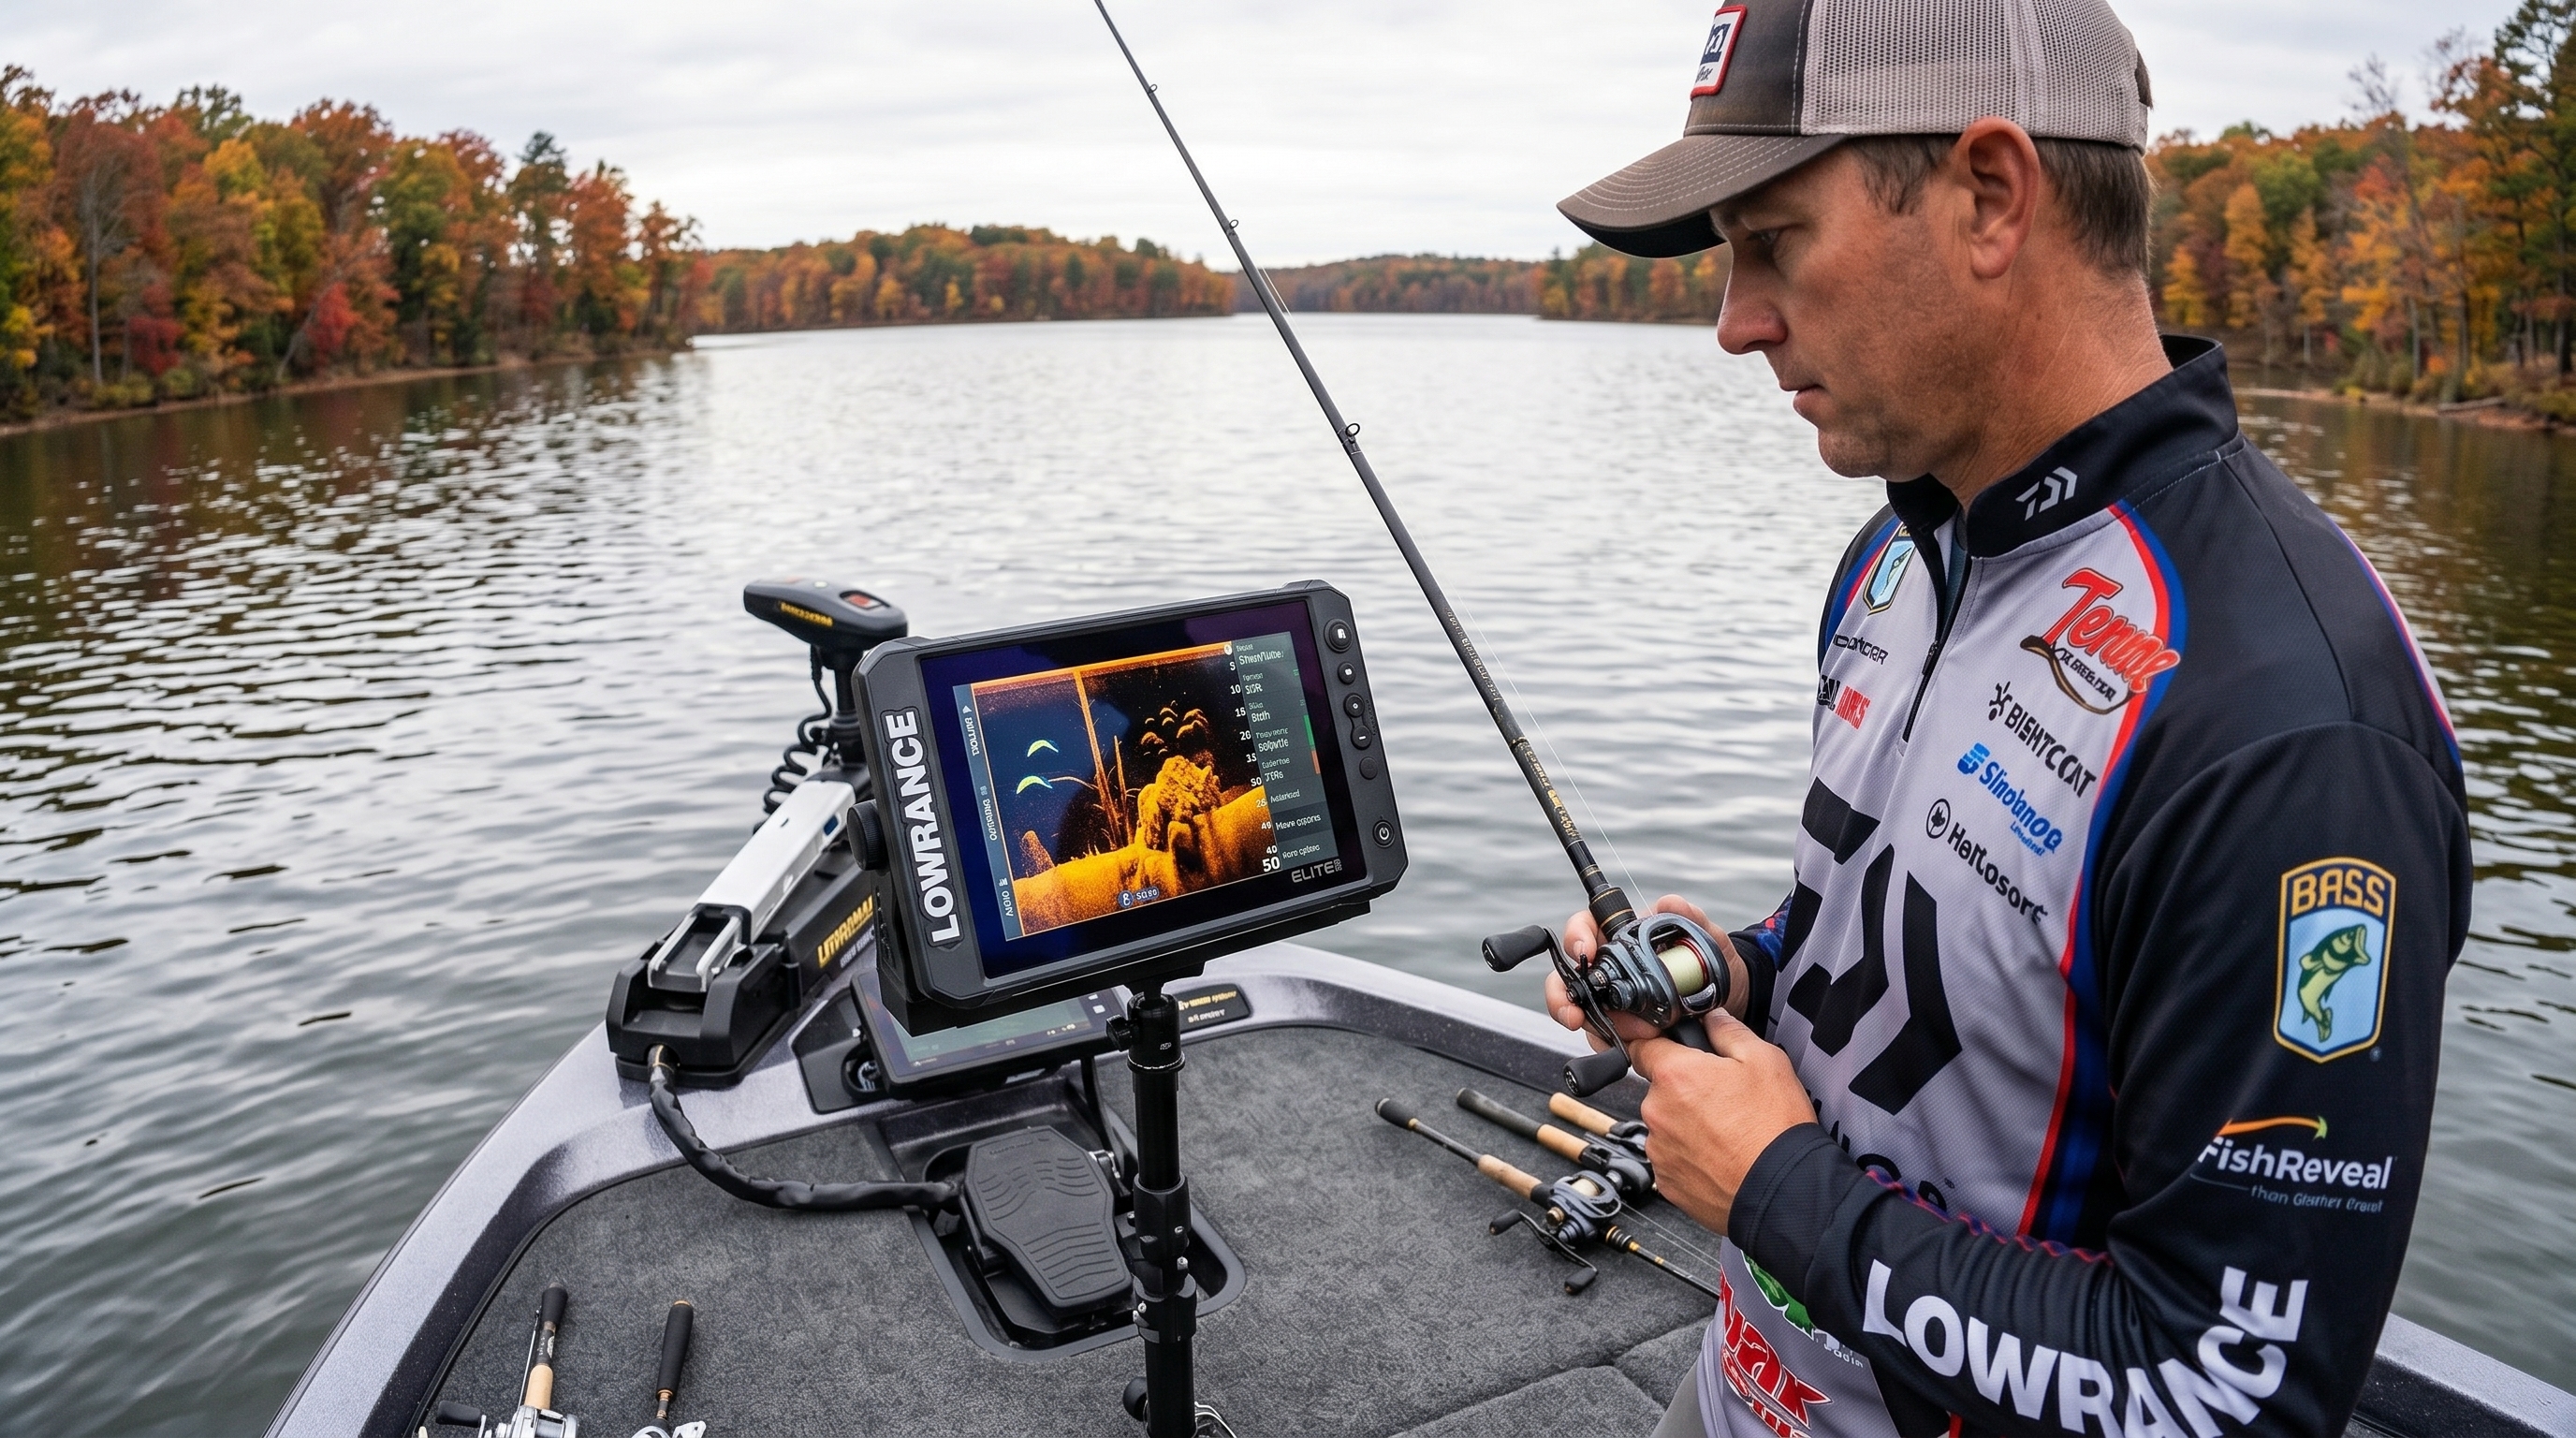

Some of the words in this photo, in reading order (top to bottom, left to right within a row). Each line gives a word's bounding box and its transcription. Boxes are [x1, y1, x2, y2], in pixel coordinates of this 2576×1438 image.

[1230, 683, 1241, 695] 10
[886, 711, 960, 943] LOWRANCE
[1266, 844, 1278, 855] 40
[1262, 856, 1281, 873] 50
[1291, 860, 1335, 884] ELITE
[2291, 868, 2385, 917] BASS
[1862, 1258, 2308, 1438] LOWRANCE
